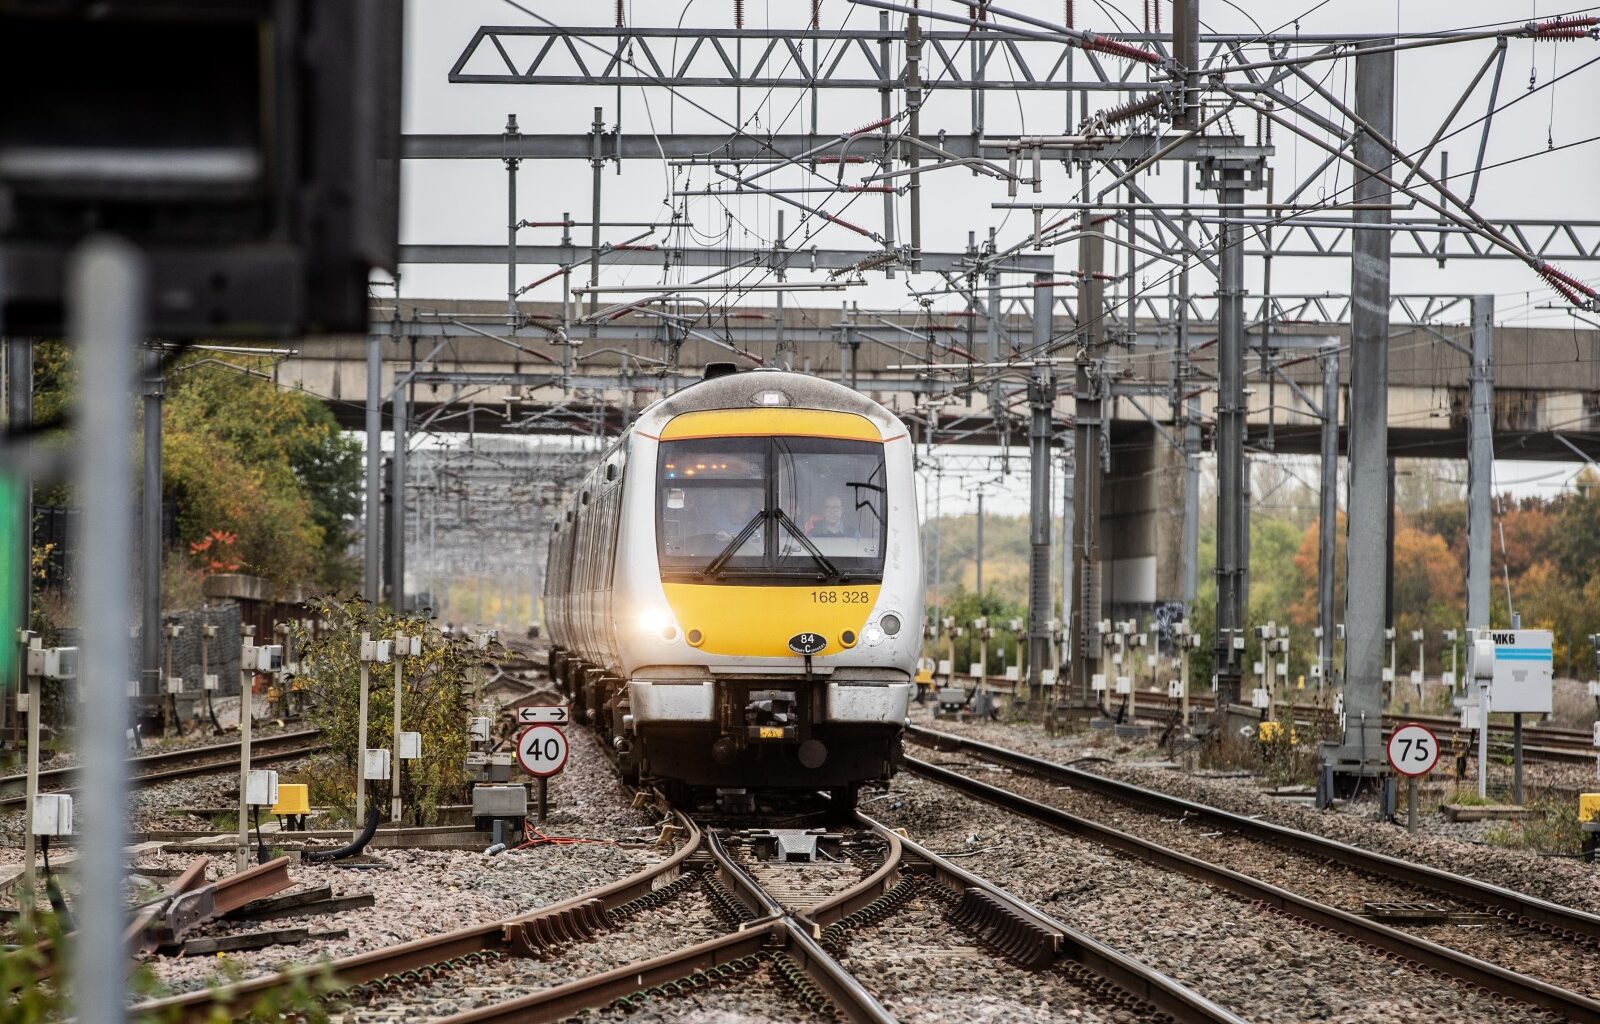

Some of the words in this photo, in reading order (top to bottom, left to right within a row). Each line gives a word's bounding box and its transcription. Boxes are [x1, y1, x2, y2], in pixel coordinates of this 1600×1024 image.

[811, 591, 837, 603] 168
[842, 591, 869, 603] 328
[801, 634, 814, 644] 84
[1492, 633, 1515, 645] MK6
[805, 645, 811, 653] C
[526, 738, 559, 761] 40
[1398, 739, 1429, 762] 75
